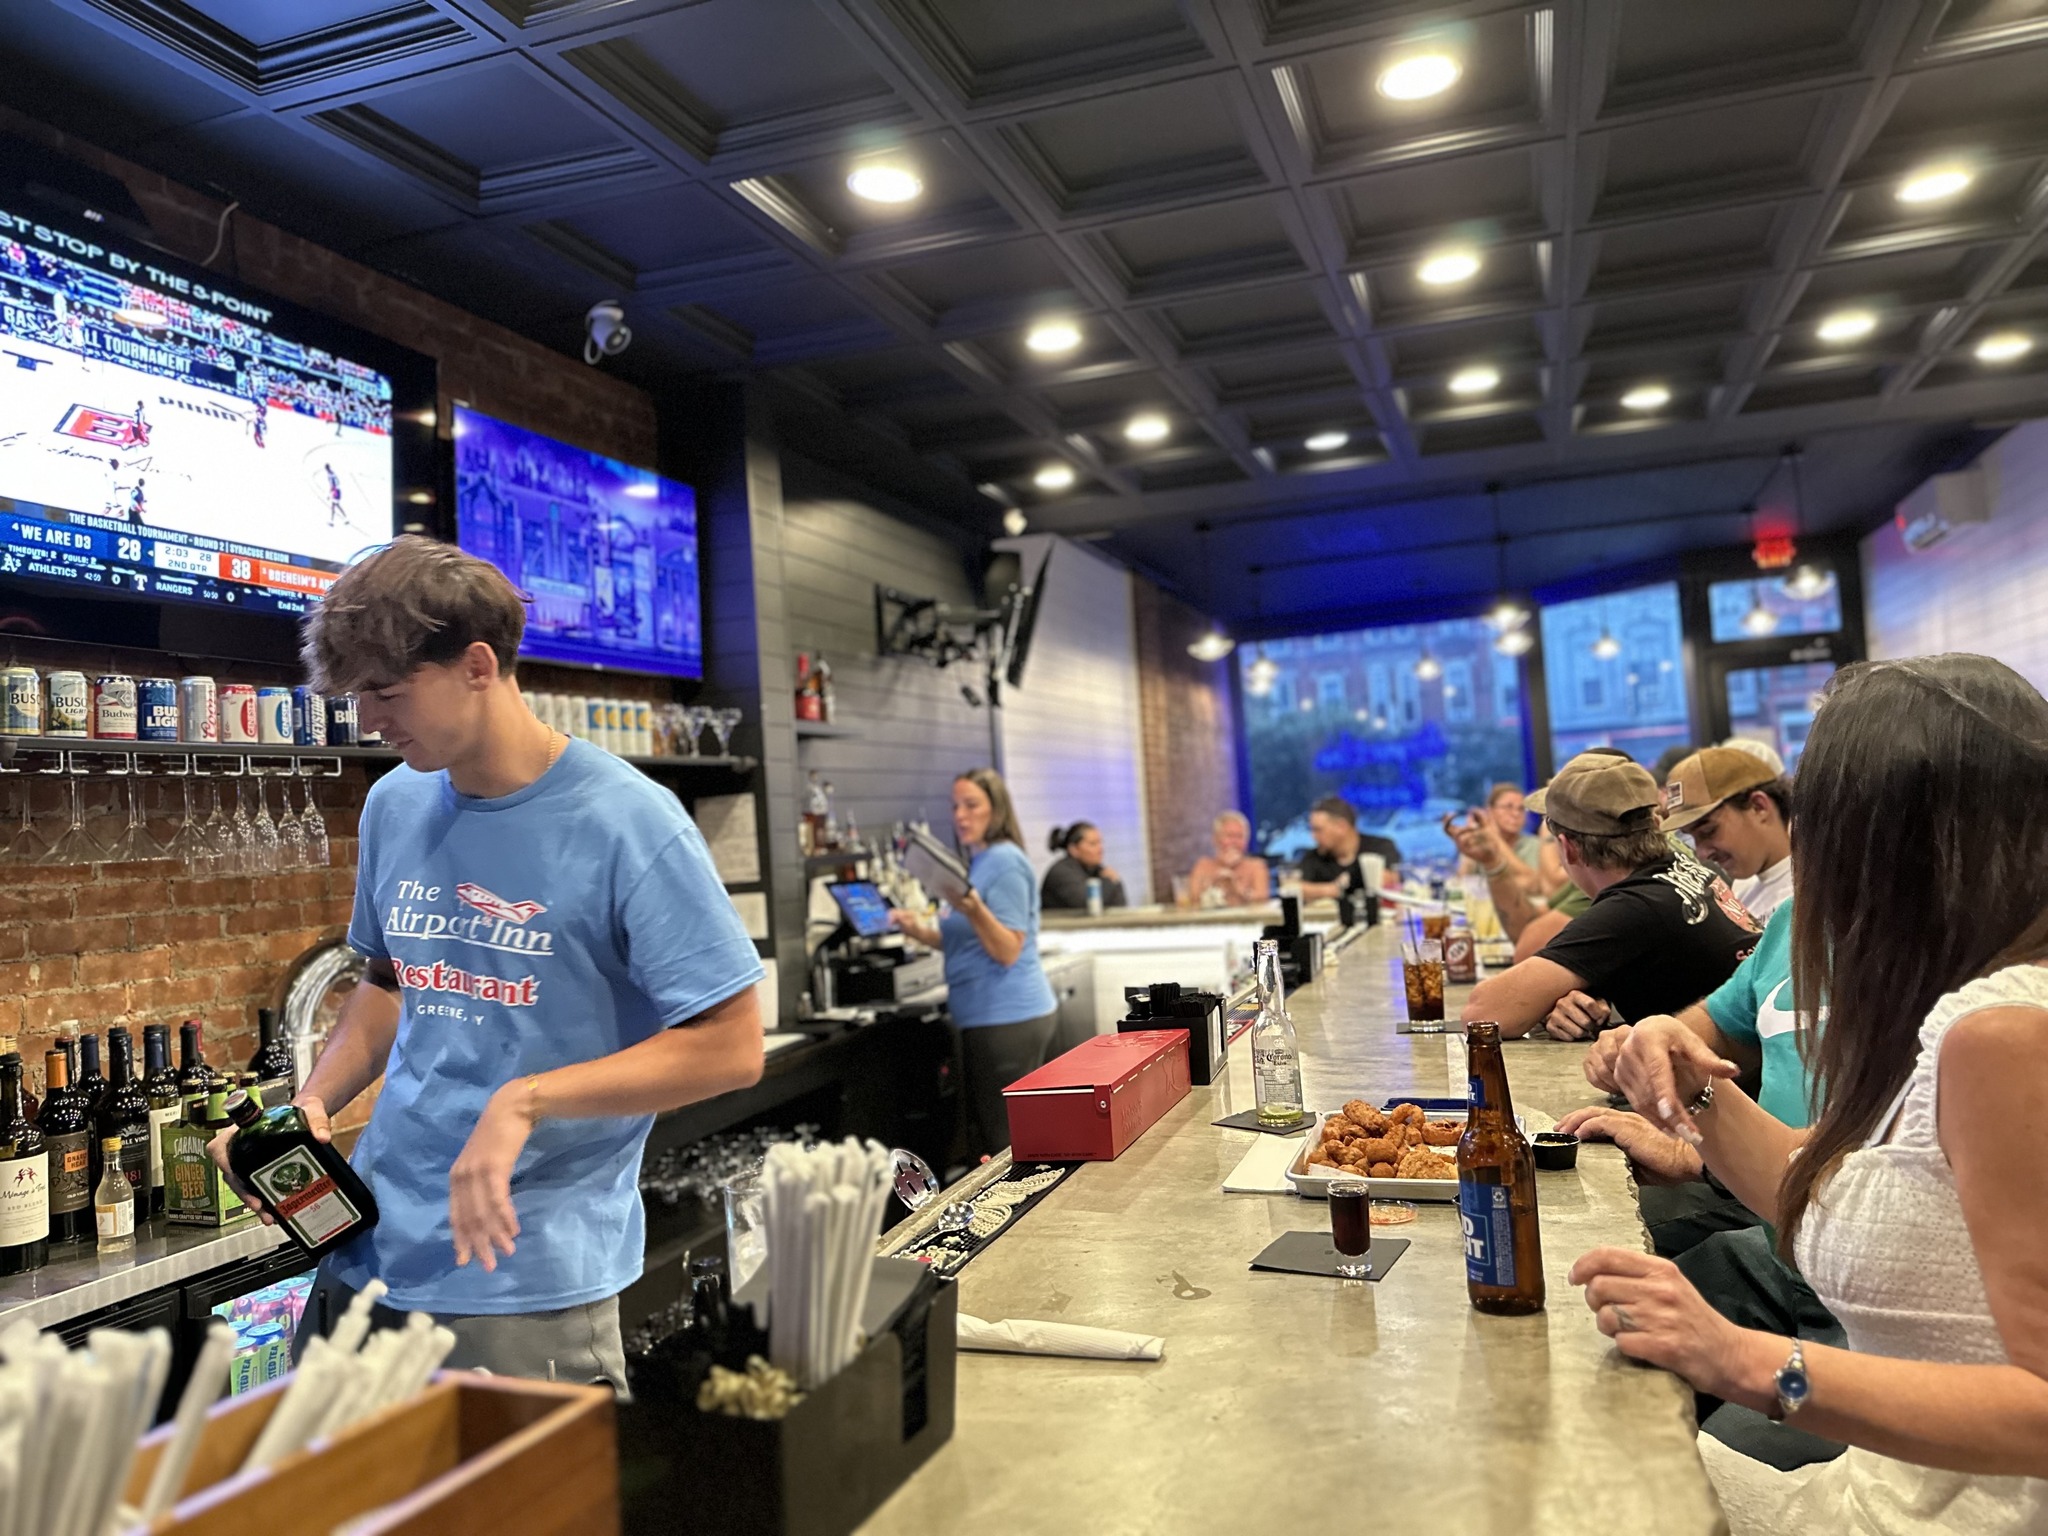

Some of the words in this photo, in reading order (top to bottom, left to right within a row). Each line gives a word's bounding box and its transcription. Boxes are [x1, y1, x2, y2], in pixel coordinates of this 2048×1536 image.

[34, 225, 104, 258] STOP
[109, 252, 140, 274] BY
[145, 265, 190, 294] THE
[103, 333, 192, 373] TOURNAMENT
[21, 525, 42, 541] WE
[46, 530, 71, 546] ARE
[75, 534, 91, 549] D3
[69, 512, 86, 525] THE
[87, 516, 137, 535] BASKETBALL
[138, 525, 188, 544] TOURNAMENT
[193, 536, 218, 550] ROUND
[118, 537, 141, 561] 28
[165, 546, 189, 558] 2:03
[200, 552, 212, 562] 28
[28, 562, 77, 578] ATHLETICS
[111, 574, 121, 585] 0
[168, 559, 187, 569] 2ND
[190, 563, 208, 572] QTR
[231, 558, 252, 580] 38
[155, 582, 193, 596] RANGERS
[226, 592, 235, 603] 0
[397, 880, 441, 901] The
[488, 918, 552, 951] Inn
[391, 958, 541, 1006] Restaurant
[175, 1163, 206, 1181] GINGER
[182, 1180, 206, 1199] BEER
